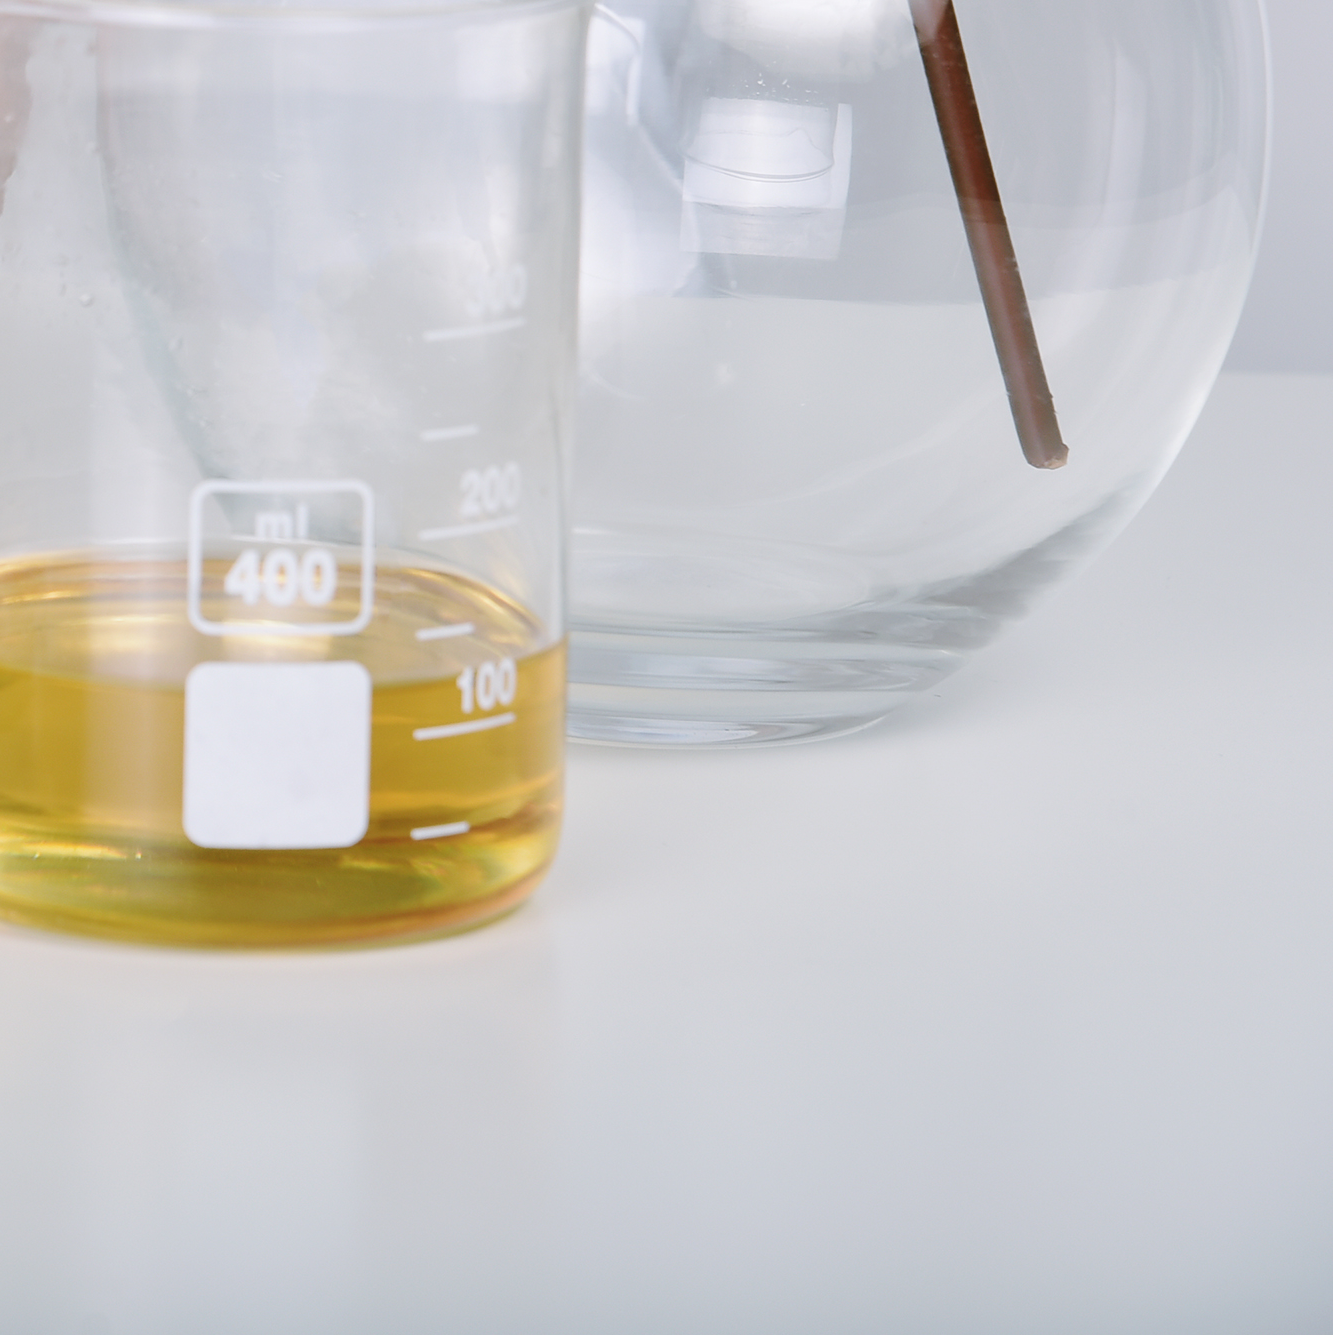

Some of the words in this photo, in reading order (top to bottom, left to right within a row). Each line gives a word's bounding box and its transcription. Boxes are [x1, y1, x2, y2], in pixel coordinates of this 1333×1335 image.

[459, 462, 520, 514] 200
[255, 503, 309, 540] ml
[224, 549, 337, 606] 400
[456, 657, 517, 714] 100
